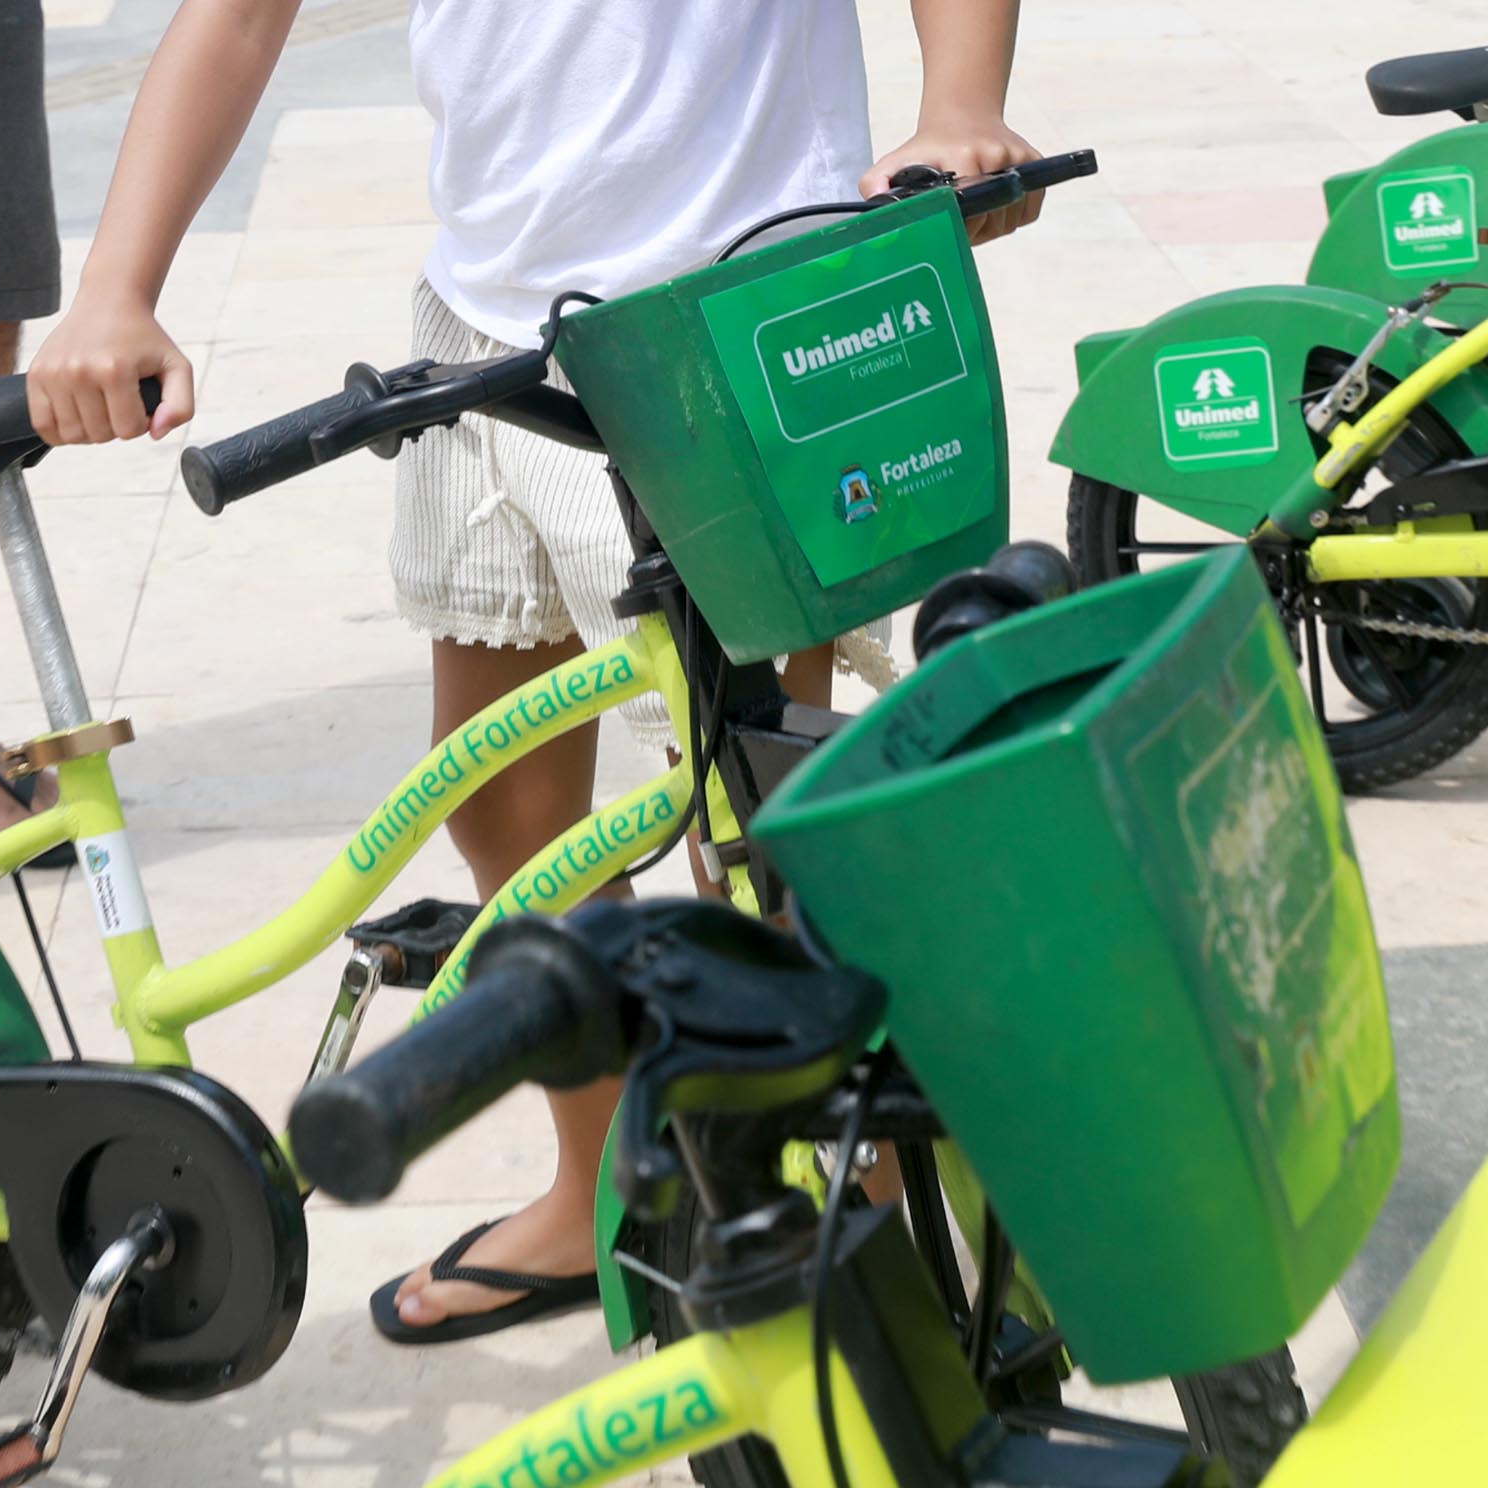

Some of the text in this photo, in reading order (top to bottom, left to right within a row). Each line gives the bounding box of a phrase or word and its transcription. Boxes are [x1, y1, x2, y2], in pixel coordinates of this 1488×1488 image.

[782, 312, 896, 377] Unimed
[849, 351, 903, 381] Fortaleza
[1175, 400, 1259, 427] Unimed
[880, 438, 962, 485] Fortaleza
[347, 651, 635, 875] Unimed Fortaleza
[512, 788, 675, 914] Fortaleza
